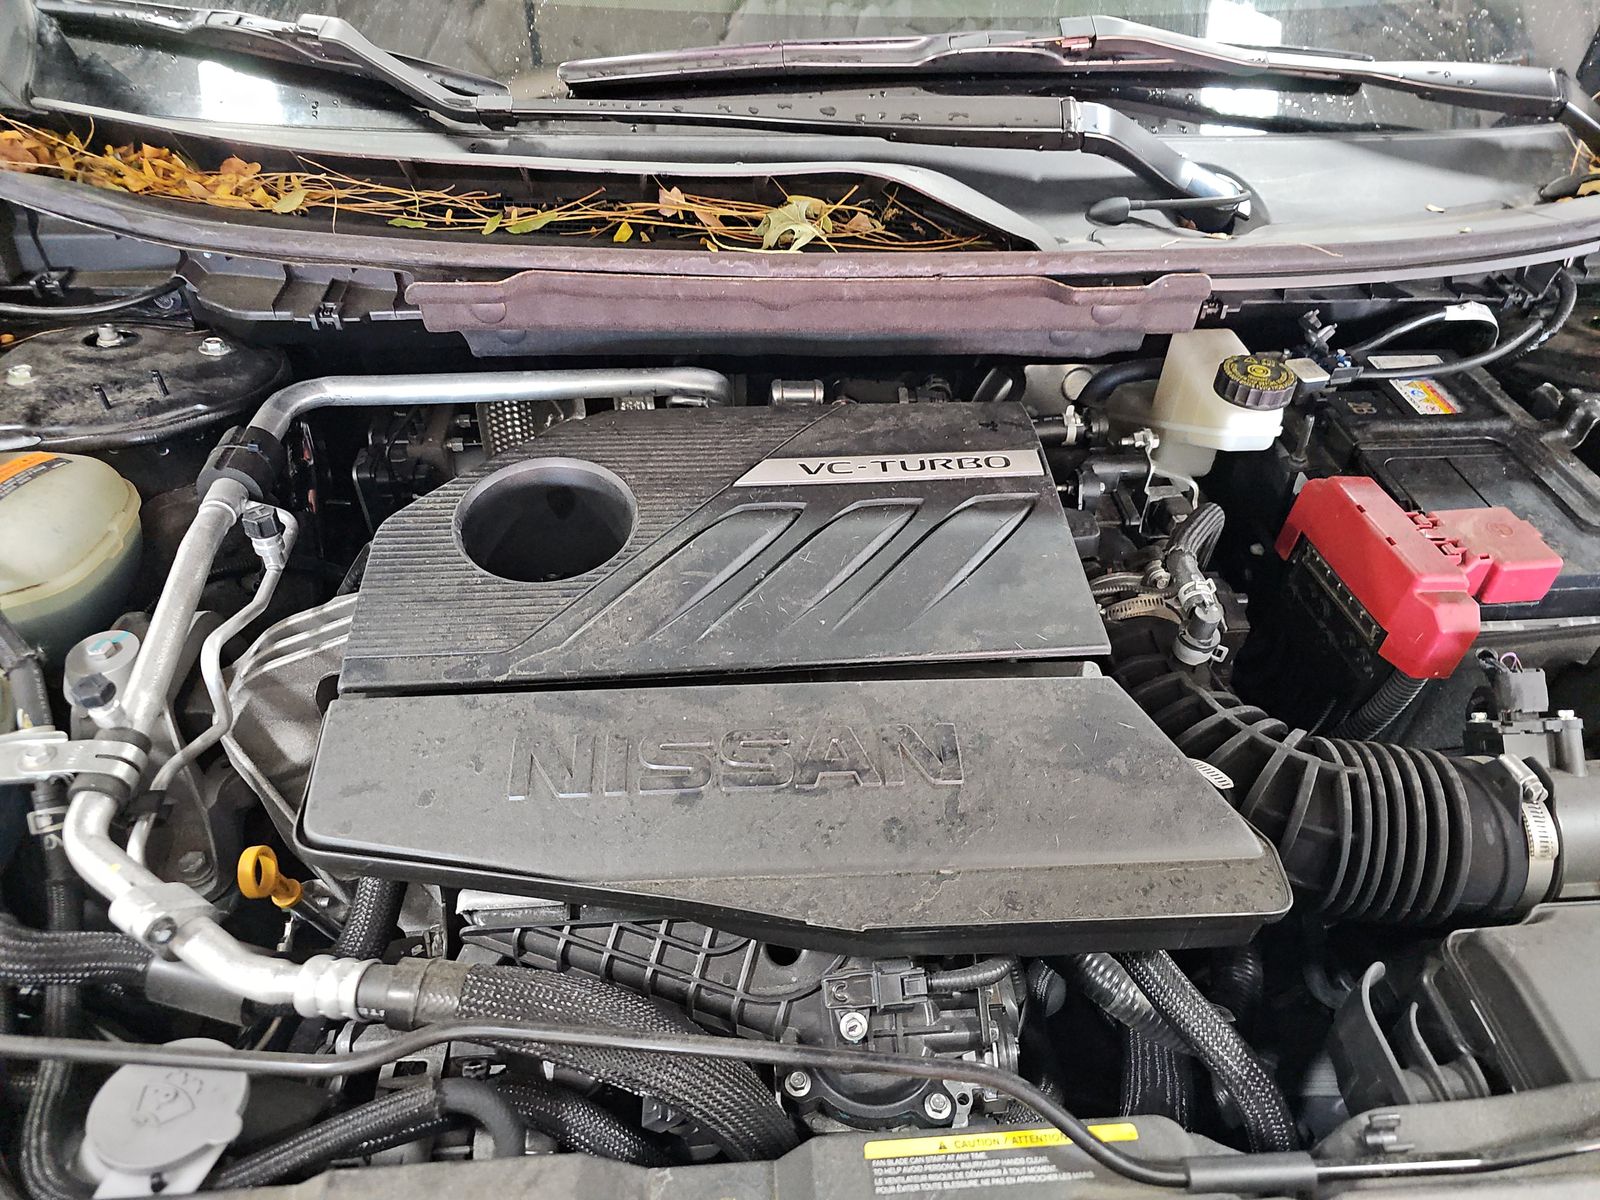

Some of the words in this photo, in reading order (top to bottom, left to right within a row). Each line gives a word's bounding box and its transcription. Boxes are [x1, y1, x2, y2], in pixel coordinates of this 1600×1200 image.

[798, 454, 1011, 475] VC-TURBO
[507, 722, 965, 800] NISSAN
[953, 1138, 1000, 1149] CAUTION
[1012, 1133, 1068, 1145] ATTENTION
[872, 1159, 886, 1167] FAN
[886, 1157, 909, 1166] BLADE
[909, 1156, 925, 1165] CAN
[925, 1154, 946, 1163] START
[947, 1153, 955, 1162] AT
[955, 1152, 970, 1161] ANY
[873, 1167, 884, 1176] TO
[884, 1166, 902, 1175] HELP
[902, 1164, 924, 1174] AVOID
[924, 1162, 960, 1172] PERSONAL
[1001, 1157, 1025, 1166] HANDS
[874, 1177, 884, 1186] LE
[954, 1171, 964, 1179] DE
[1008, 1166, 1026, 1175] TOUT
[875, 1186, 896, 1194] POUR
[920, 1181, 943, 1191] TOUTE
[1059, 1172, 1072, 1180] LES
